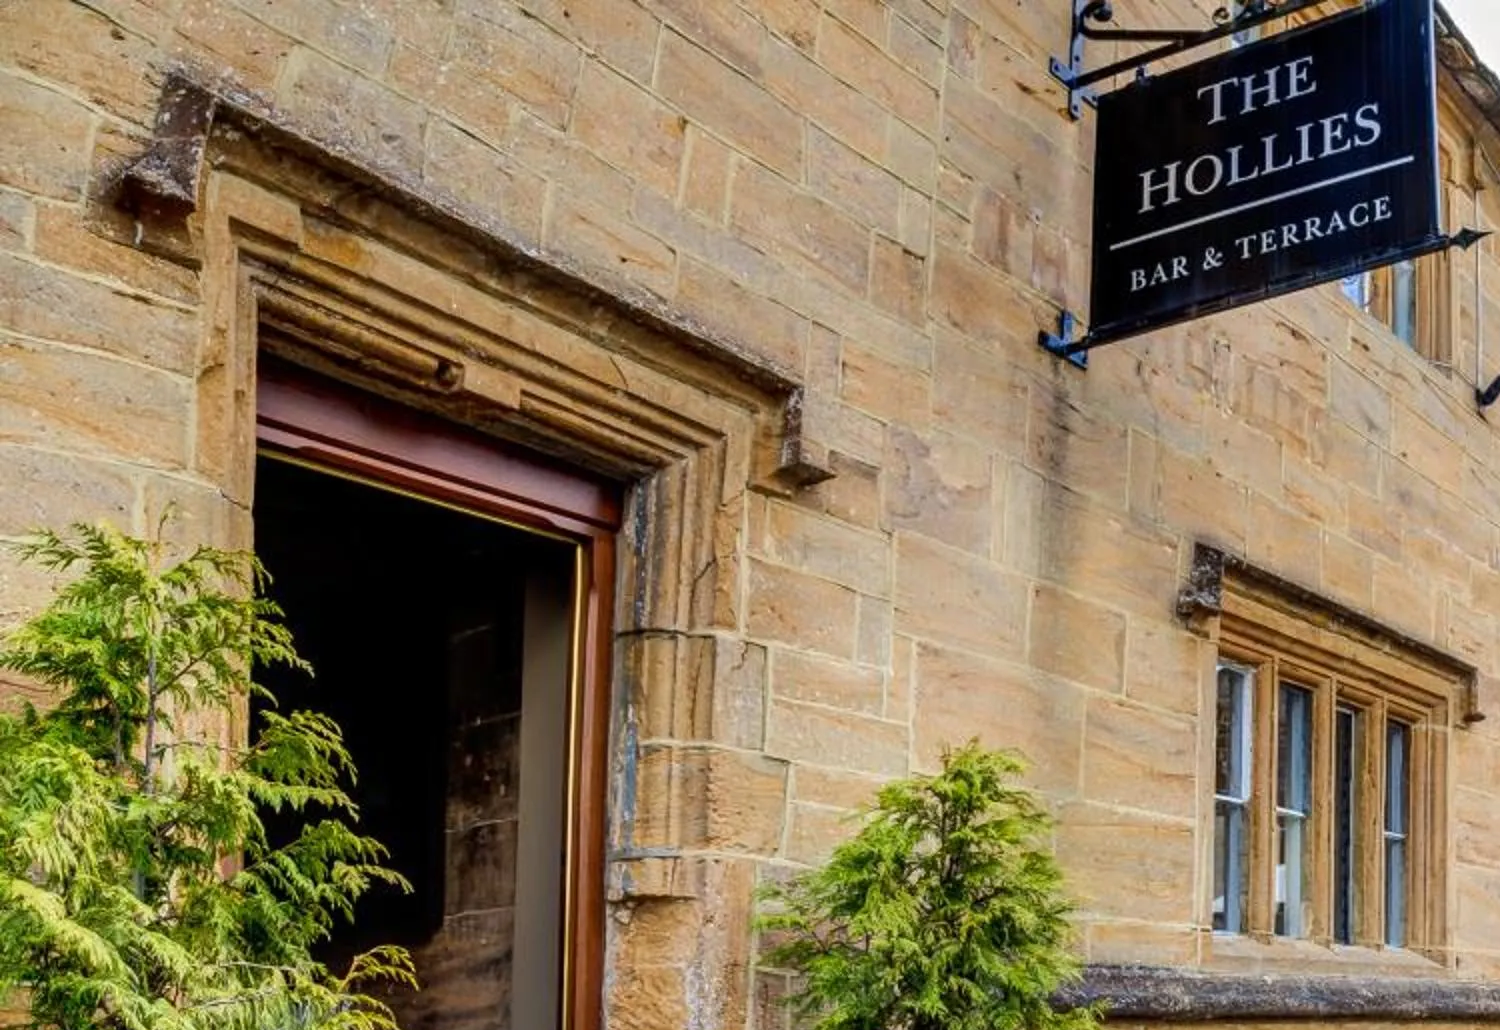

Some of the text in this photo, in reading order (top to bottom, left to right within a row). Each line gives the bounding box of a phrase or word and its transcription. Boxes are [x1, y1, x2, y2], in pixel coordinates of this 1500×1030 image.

[1197, 55, 1318, 126] THE
[1137, 103, 1382, 215] HOLLIES
[1130, 195, 1393, 292] BAR & TERRACE
